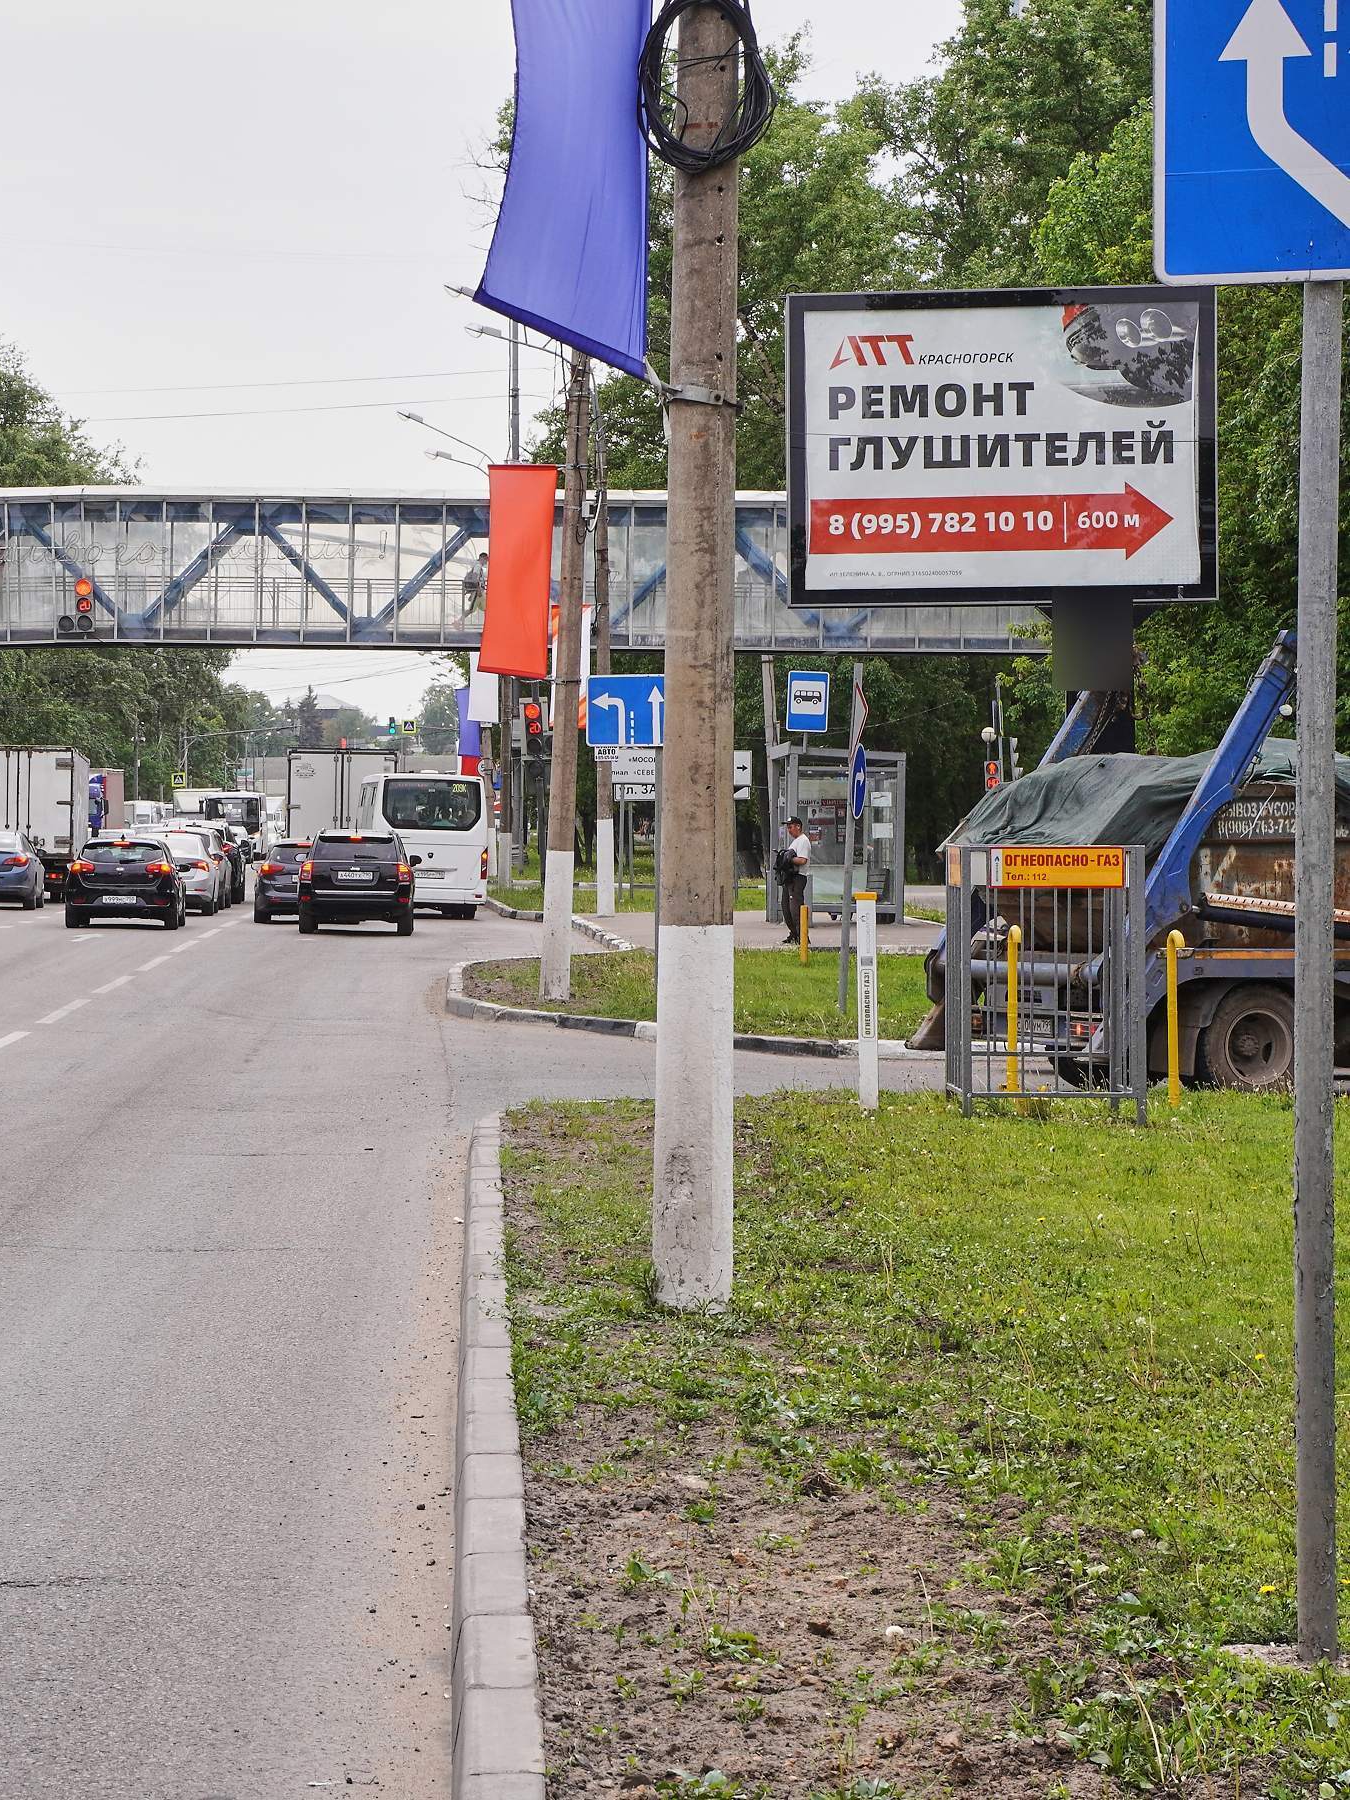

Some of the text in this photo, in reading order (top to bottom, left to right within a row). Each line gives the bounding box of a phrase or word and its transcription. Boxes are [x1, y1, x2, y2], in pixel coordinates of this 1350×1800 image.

[918, 352, 1014, 365] КРАСНОГОРСК
[828, 382, 1035, 420] РЕМОНТ
[828, 420, 1174, 471] ГЛУШИТЕЛЕЙ
[828, 510, 1140, 540] 8 (995) 782 10 10 600 м
[529, 722, 541, 733] 20
[597, 748, 616, 756] АВТО
[1004, 853, 1121, 867] ОГНЕОПАСНО-ГАЗ
[1005, 872, 1030, 882] Тел.:
[1033, 873, 1047, 881] 112
